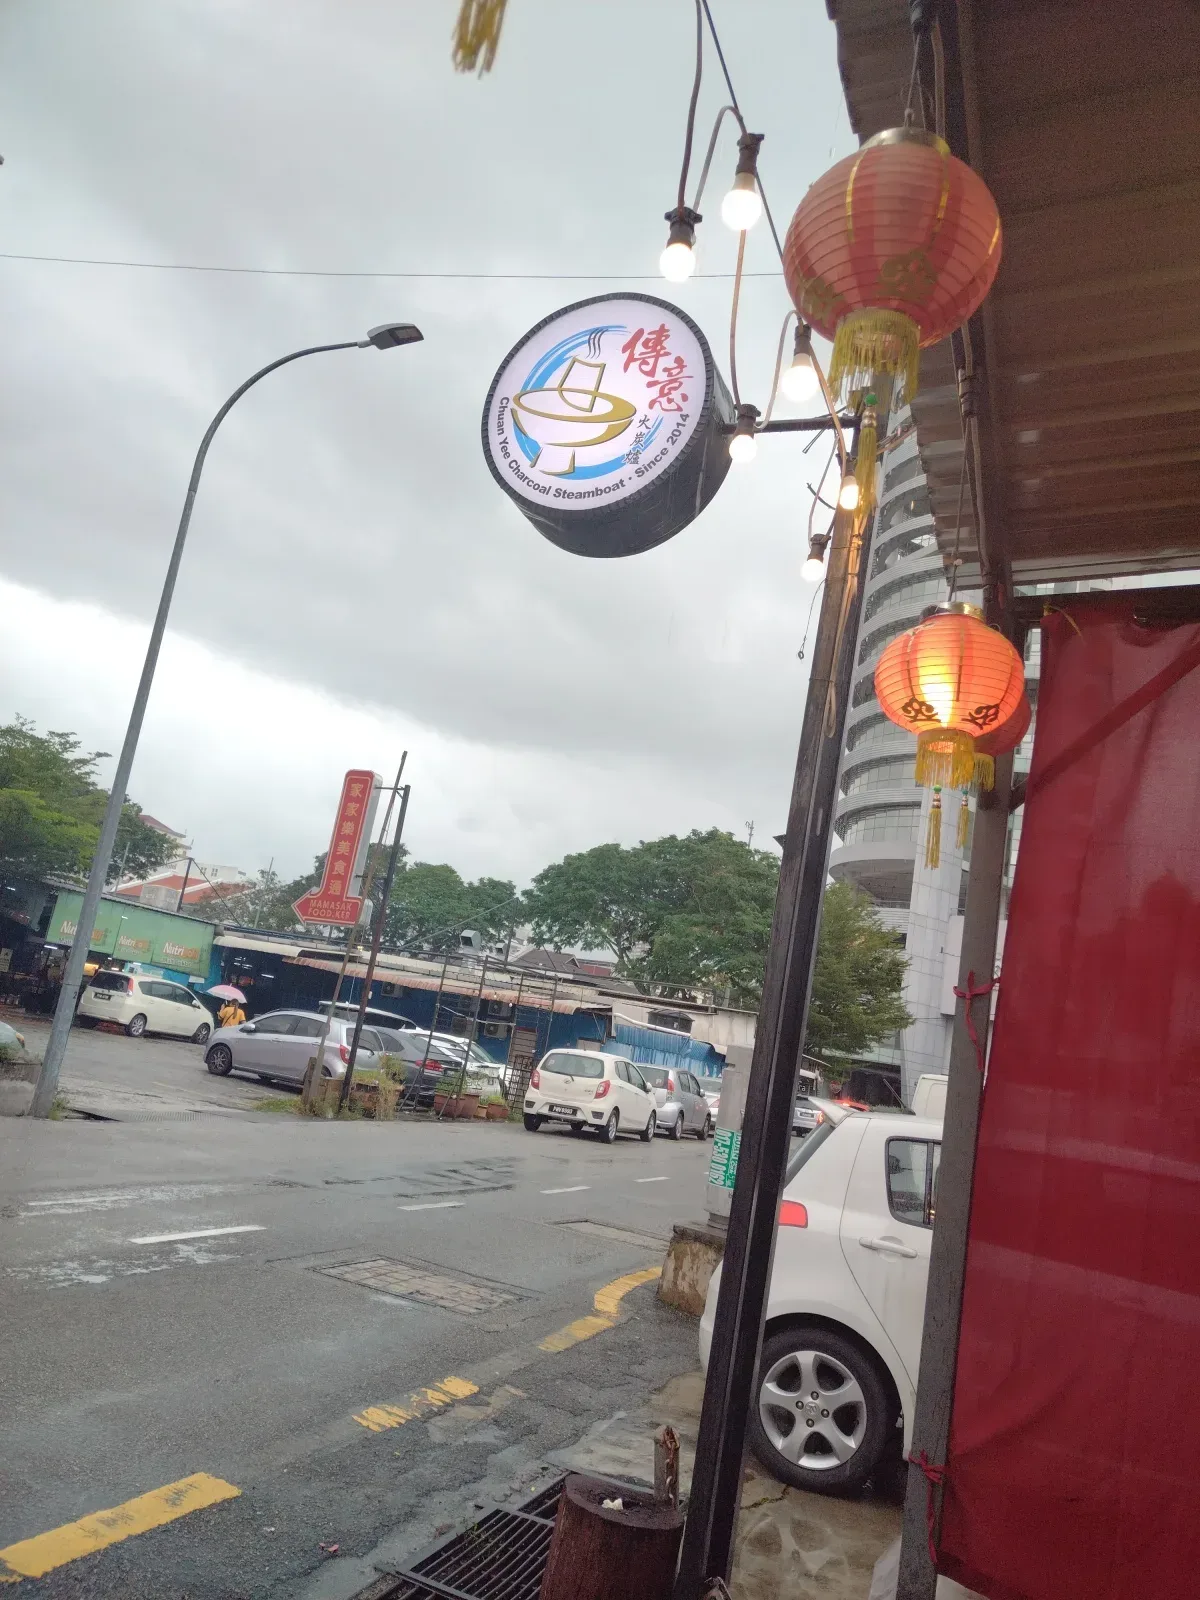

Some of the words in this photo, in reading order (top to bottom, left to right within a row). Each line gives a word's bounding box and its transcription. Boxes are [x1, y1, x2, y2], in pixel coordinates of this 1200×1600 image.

[622, 323, 694, 412] 傳意
[497, 397, 510, 436] Chuan
[666, 413, 690, 446] 2014
[499, 437, 511, 459] Yee
[635, 447, 669, 478] Since
[508, 460, 552, 495] Charcoal
[553, 478, 626, 500] Steamboat
